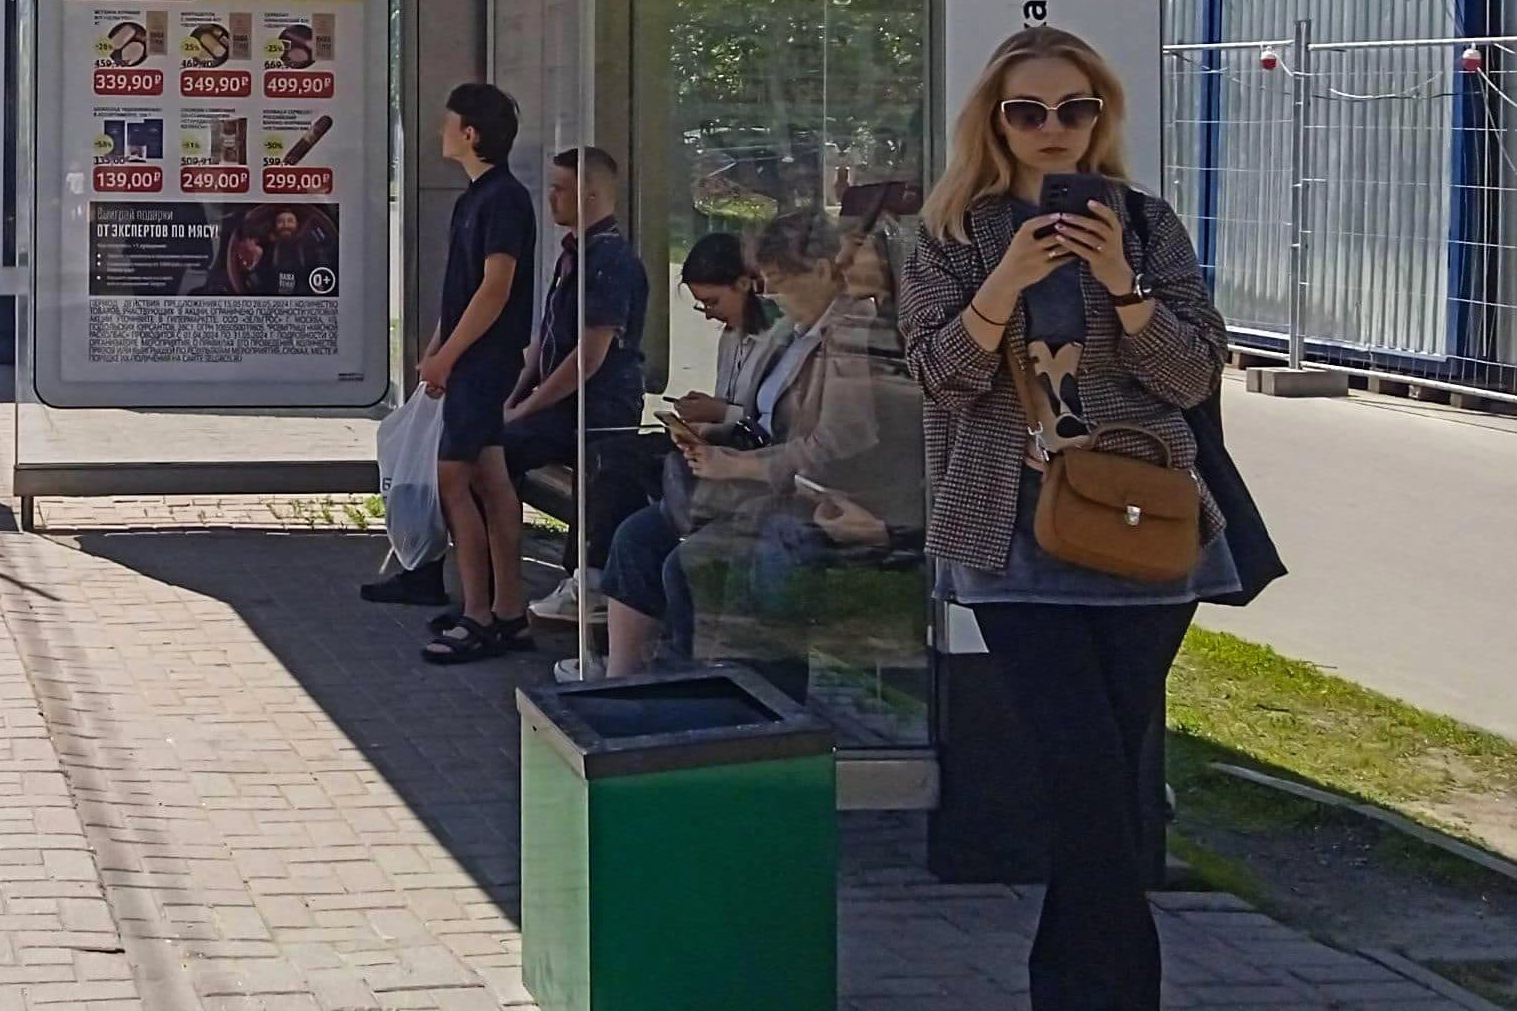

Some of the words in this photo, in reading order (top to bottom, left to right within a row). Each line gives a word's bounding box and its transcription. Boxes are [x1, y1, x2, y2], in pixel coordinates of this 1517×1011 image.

[97, 224, 110, 238] ОТ
[111, 224, 168, 238] ЭКСПЕРТОВ
[171, 224, 185, 238] ПО
[188, 224, 219, 238] МЯСУ!
